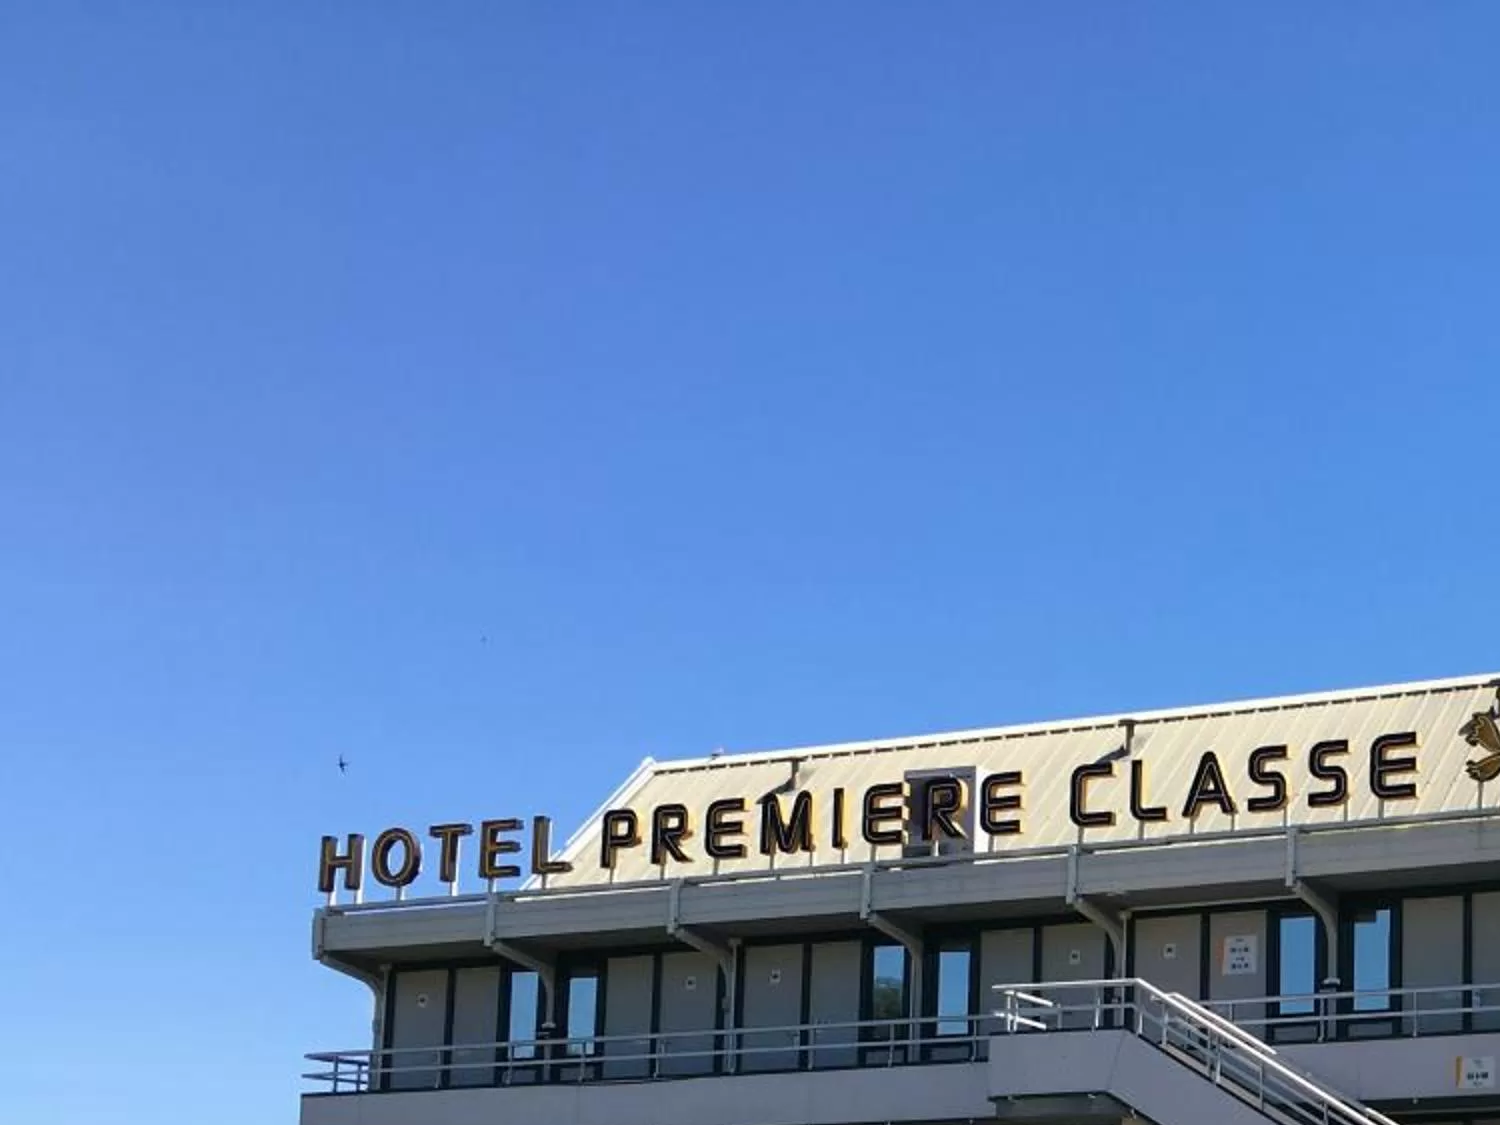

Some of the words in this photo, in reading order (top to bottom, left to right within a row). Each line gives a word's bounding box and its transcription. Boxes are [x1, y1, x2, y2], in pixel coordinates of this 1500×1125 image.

[318, 815, 573, 893] HOTEL
[600, 770, 1023, 869] PREMIERE
[1069, 730, 1419, 827] CLASSE
